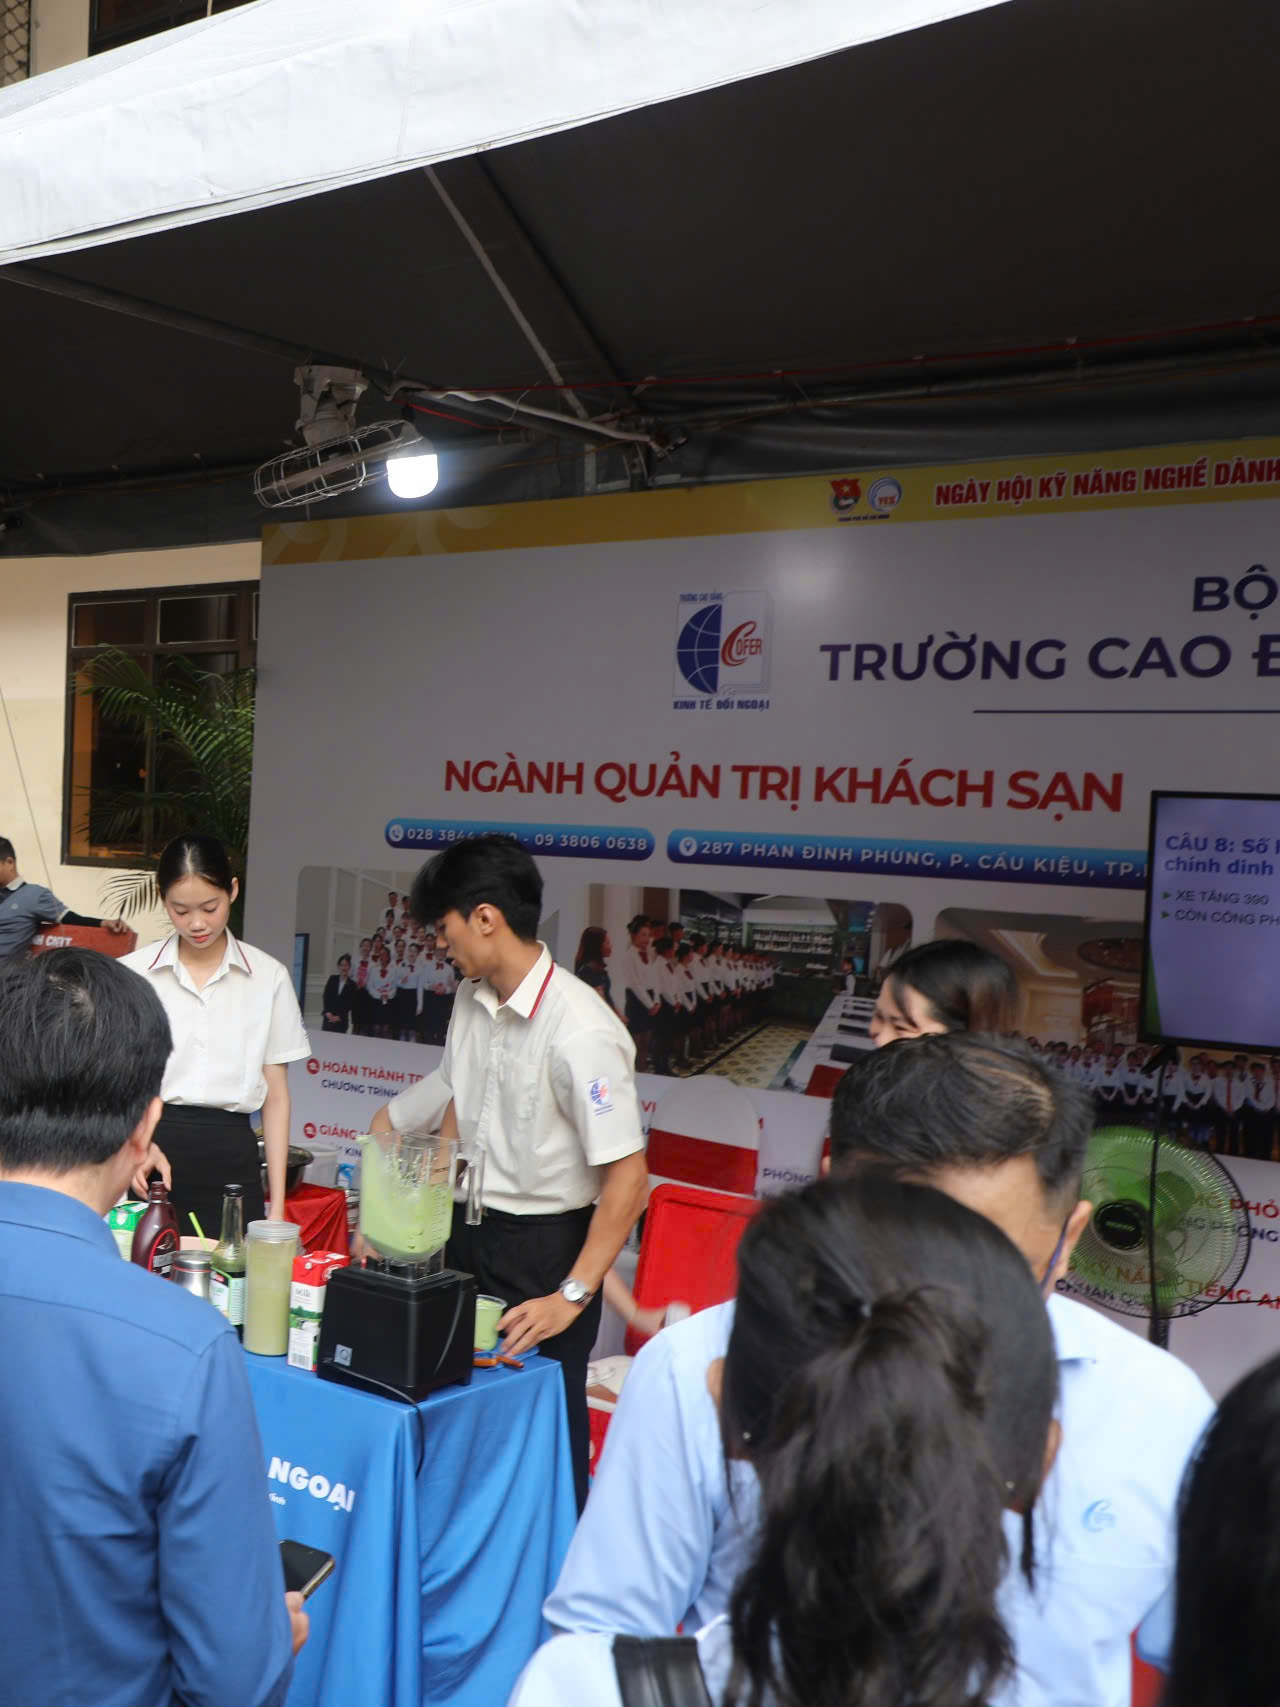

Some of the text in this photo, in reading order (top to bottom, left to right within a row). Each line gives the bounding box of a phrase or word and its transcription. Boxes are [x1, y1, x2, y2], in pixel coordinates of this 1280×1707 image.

[935, 479, 990, 504] NGÀY
[996, 474, 1033, 505] HỘI
[1038, 472, 1067, 498] KỸ
[1073, 468, 1136, 495] NĂNG
[1215, 458, 1280, 486] DÀNH
[1193, 564, 1278, 620] BỘ
[721, 620, 762, 667] COFER
[820, 631, 1067, 681] TRƯỜNG
[1089, 635, 1232, 679] CAO
[673, 700, 696, 710] KINH
[700, 698, 713, 710] TẾ
[737, 699, 770, 712] NGOẠI
[444, 750, 1124, 822] NGÀNH QUẢN TRỊ KHÁCH SẠN
[408, 828, 432, 840] 028
[535, 834, 553, 846] 09
[560, 835, 600, 848] 3806
[606, 837, 647, 851] 0638
[1166, 832, 1208, 850] CÂU
[1215, 838, 1234, 852] 8:
[1242, 837, 1270, 854] Số
[701, 842, 735, 855] 287
[949, 853, 969, 868] P.
[1034, 856, 1096, 877] KIỆU,
[1104, 861, 1147, 878] TP.
[1165, 856, 1220, 872] chính
[1176, 890, 1195, 901] XE
[323, 1061, 358, 1075] HOÀN
[361, 1065, 405, 1083] THÀNH
[321, 1079, 365, 1093] CHƯƠNG
[319, 1123, 357, 1140] GIẢNG
[267, 1456, 355, 1512] NGOẠI
